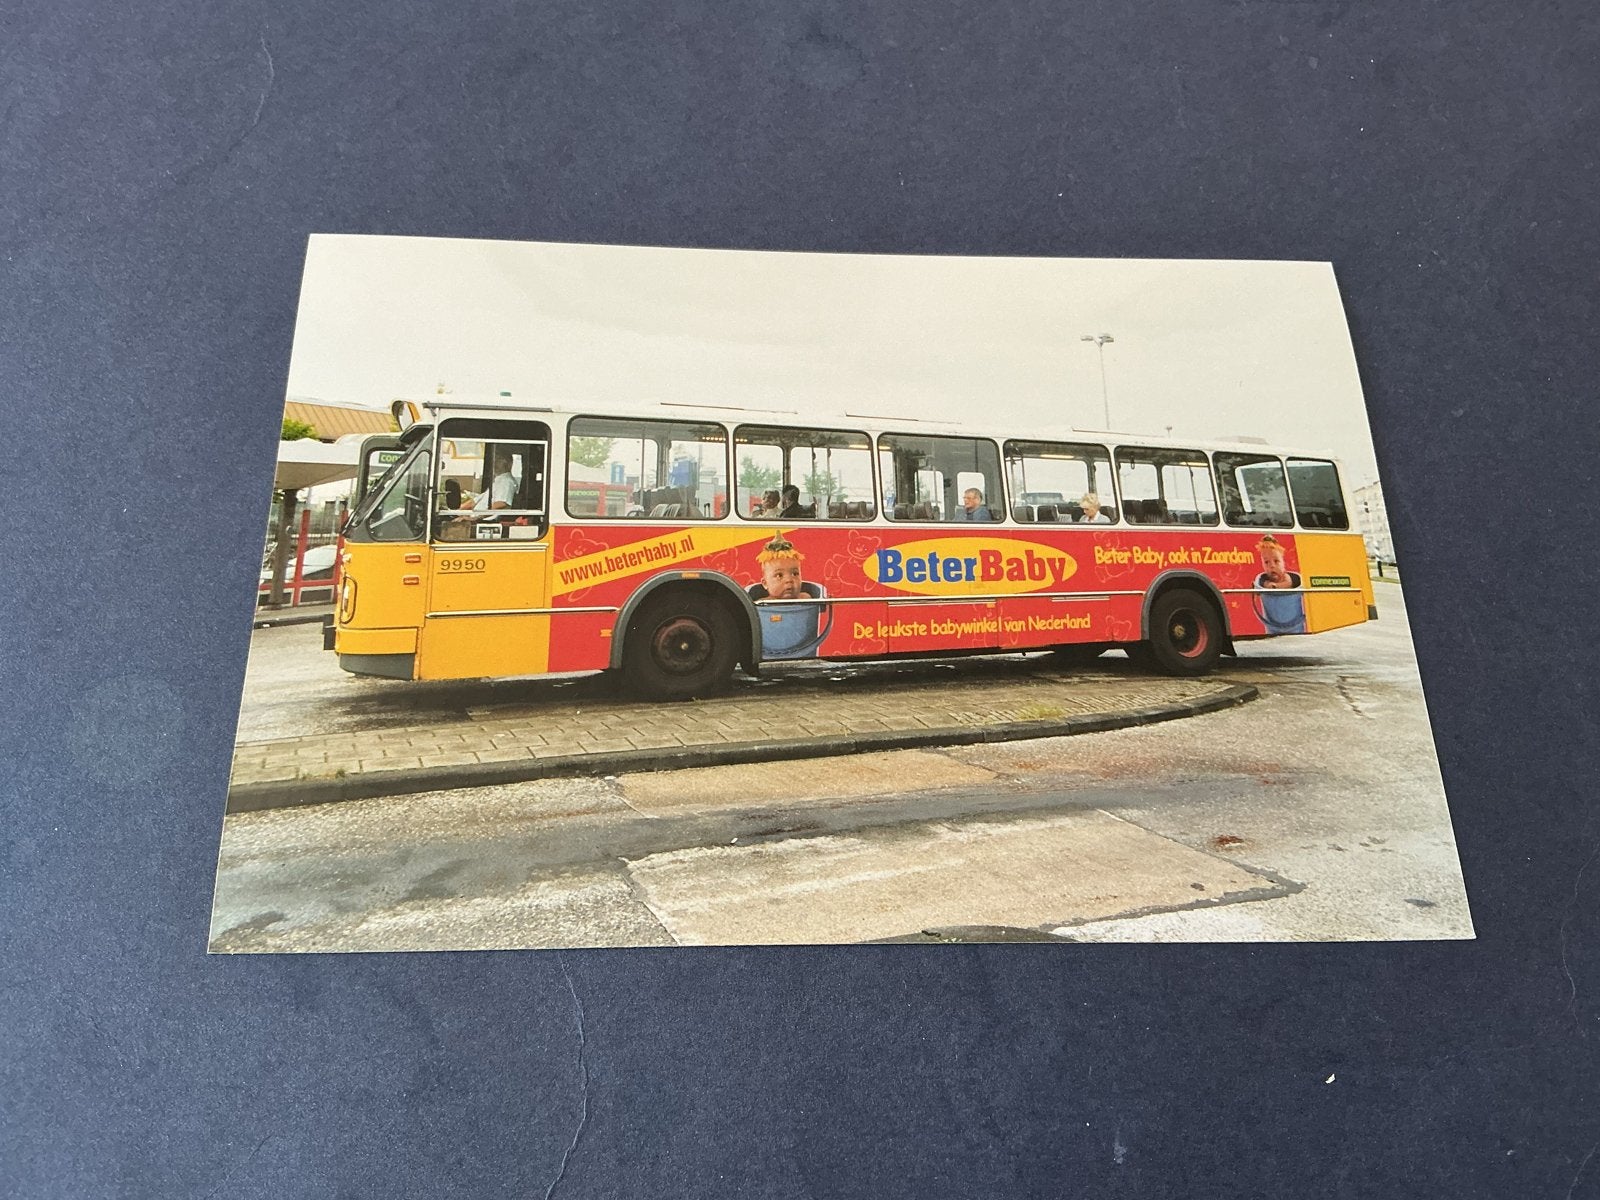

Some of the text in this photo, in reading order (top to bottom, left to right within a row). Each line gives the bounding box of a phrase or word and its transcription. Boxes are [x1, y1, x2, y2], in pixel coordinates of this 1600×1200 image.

[440, 558, 486, 571] 9950
[559, 534, 695, 585] www.beterbaby.nl
[877, 549, 1066, 587] BeterBaby
[1094, 546, 1254, 569] Beter Baby, ook in Zaandam
[853, 613, 1091, 639] De leukste babywinkel van Nederland
